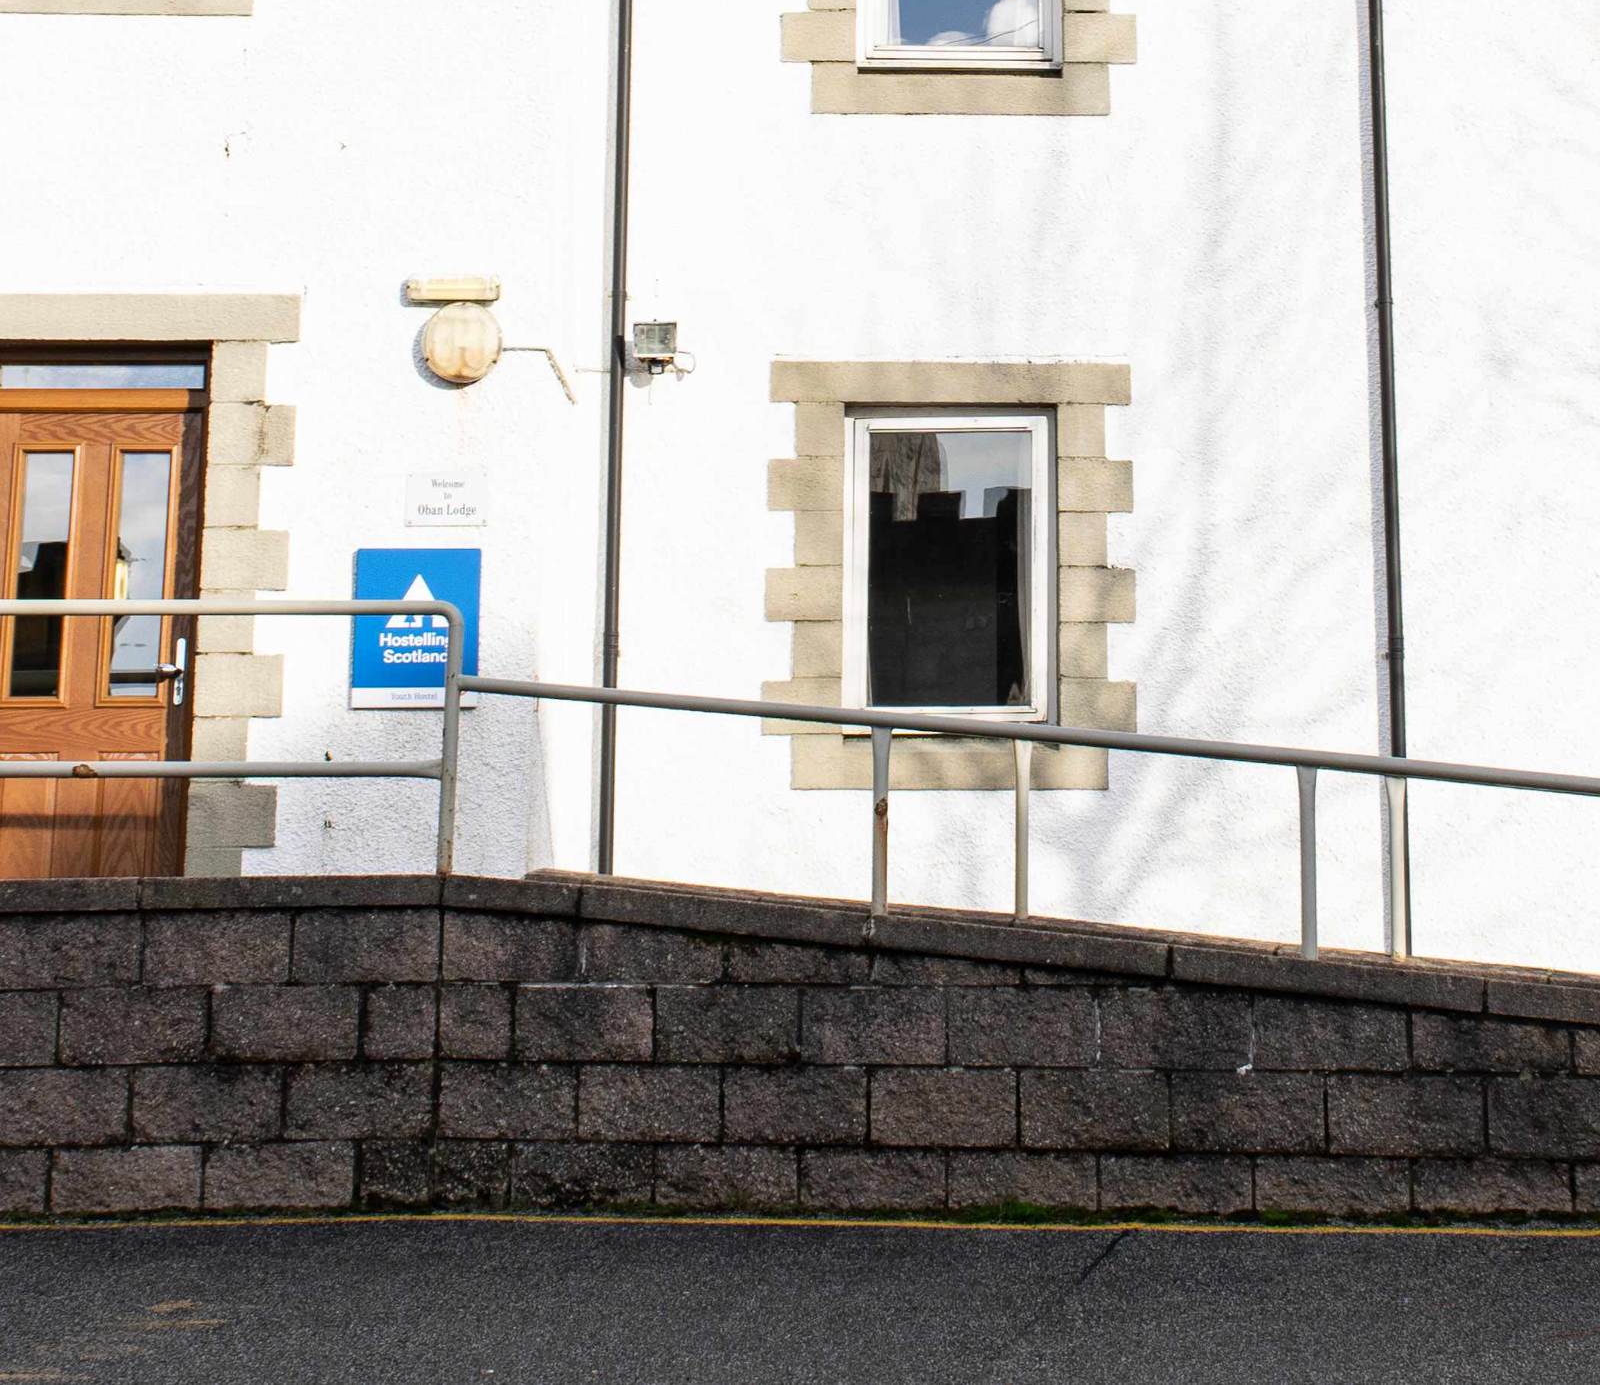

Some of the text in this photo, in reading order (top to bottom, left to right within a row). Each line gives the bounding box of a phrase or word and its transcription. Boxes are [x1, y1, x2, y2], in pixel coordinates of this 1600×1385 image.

[430, 478, 465, 488] Welcome
[443, 492, 453, 500] to
[417, 503, 477, 518] Oban Lodge
